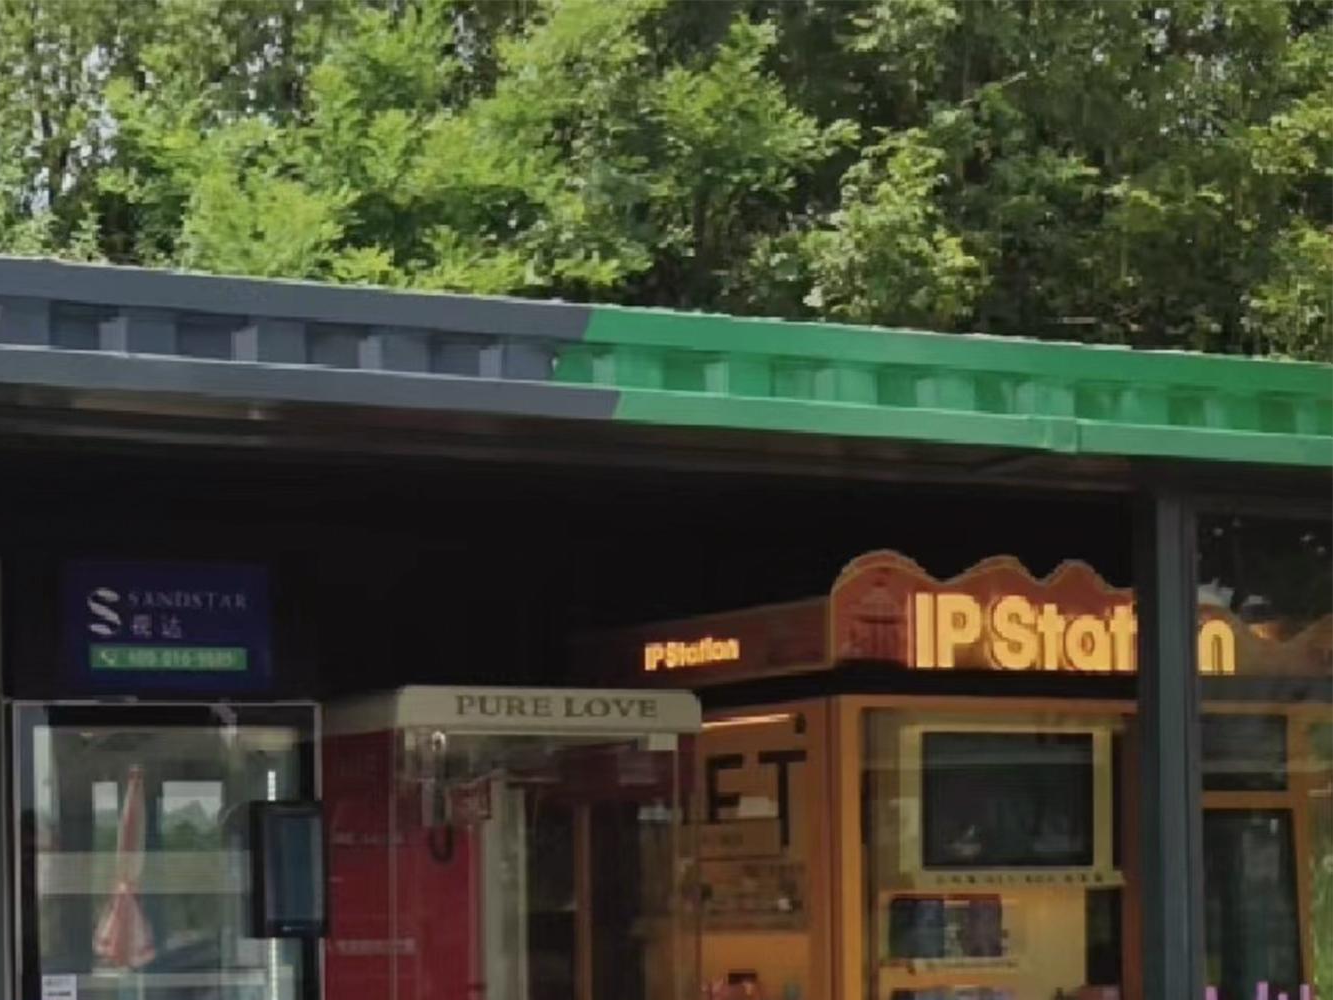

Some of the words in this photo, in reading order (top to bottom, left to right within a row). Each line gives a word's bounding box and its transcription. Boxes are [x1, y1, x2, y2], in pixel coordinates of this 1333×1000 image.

[127, 589, 248, 610] SANDSTAR
[455, 694, 554, 717] PURE
[563, 696, 658, 718] LOVE
